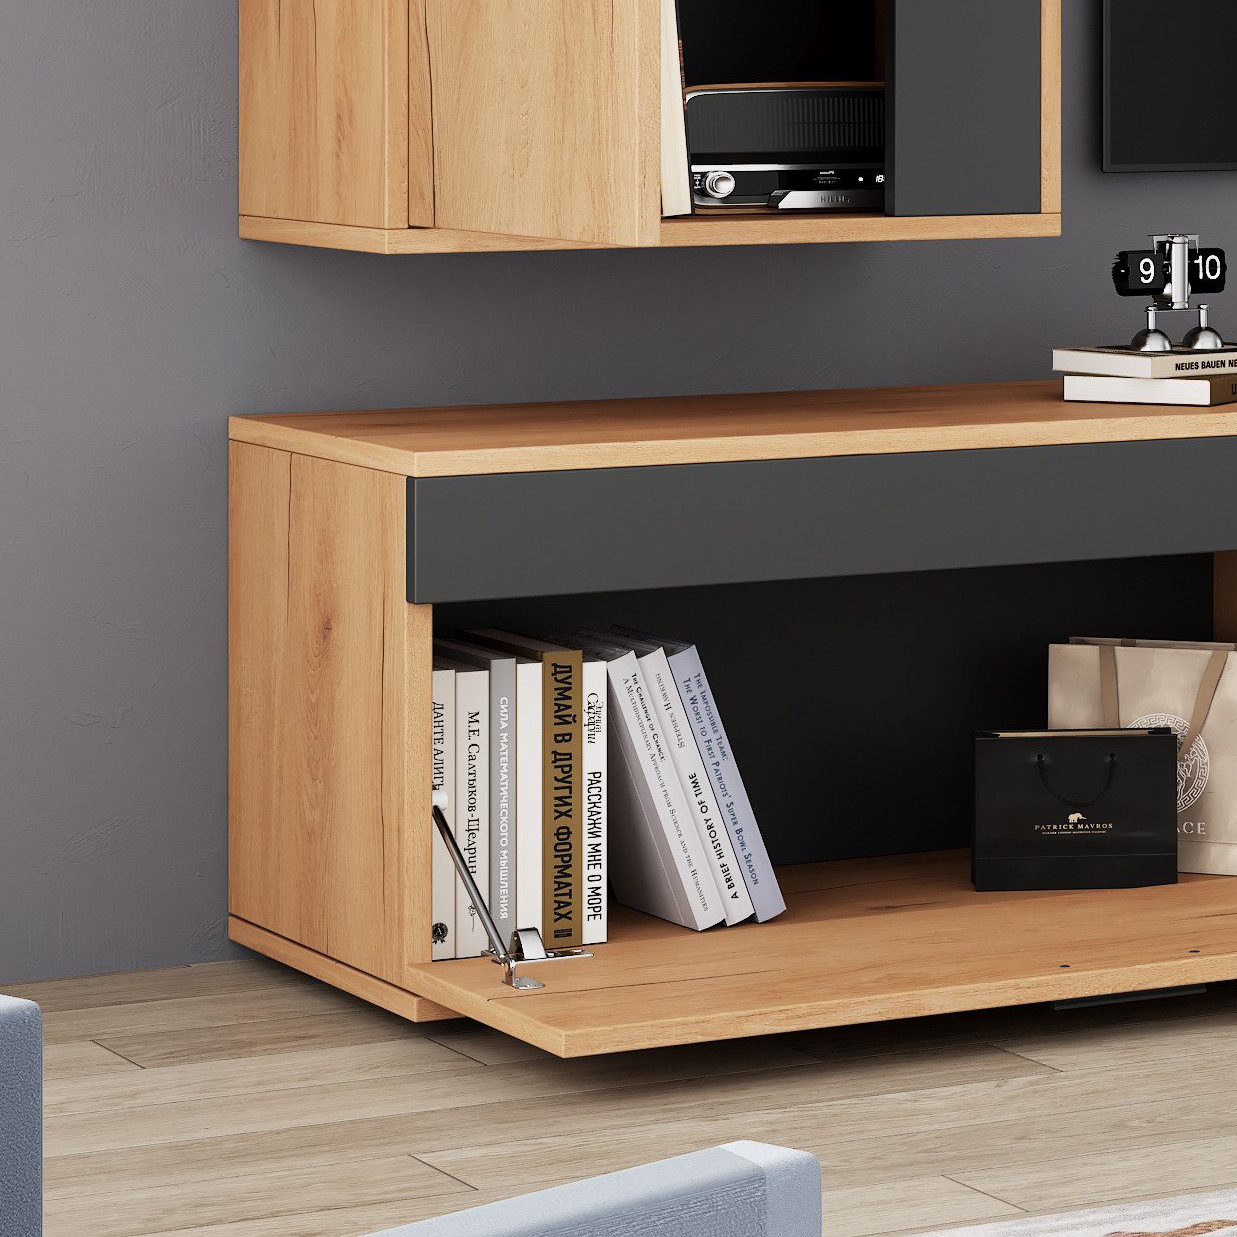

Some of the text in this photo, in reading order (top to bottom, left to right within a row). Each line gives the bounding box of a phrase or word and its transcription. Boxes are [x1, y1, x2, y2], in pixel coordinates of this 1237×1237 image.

[1139, 254, 1221, 284] 9 10
[1175, 361, 1200, 371] NEUES
[1201, 359, 1226, 370] BAUEN
[432, 701, 444, 745] ДАНТЕ
[467, 711, 480, 741] М.Е.
[551, 663, 577, 726] ДУМАЙ
[693, 672, 701, 689] THE
[699, 690, 719, 735] IMPOSSIBLE
[553, 732, 573, 744] В
[499, 696, 509, 919] СИЛА МАТЕМАТИЧЕСКОГО МЫШЛЕНИЯ
[551, 750, 573, 821] ДРУГИХ
[683, 677, 693, 694] THE
[689, 694, 703, 724] WORST
[699, 726, 708, 737] TO
[704, 738, 716, 759] FIRST
[725, 801, 739, 827] SUPER
[735, 827, 747, 852] BOWL
[743, 853, 759, 885] SEASON
[587, 771, 602, 922] РАССКАЖИ МНЕ О МОРЕ
[688, 772, 740, 899] A BRIEF HISTORY OF TIME
[553, 825, 573, 923] ФОРМАТАХ
